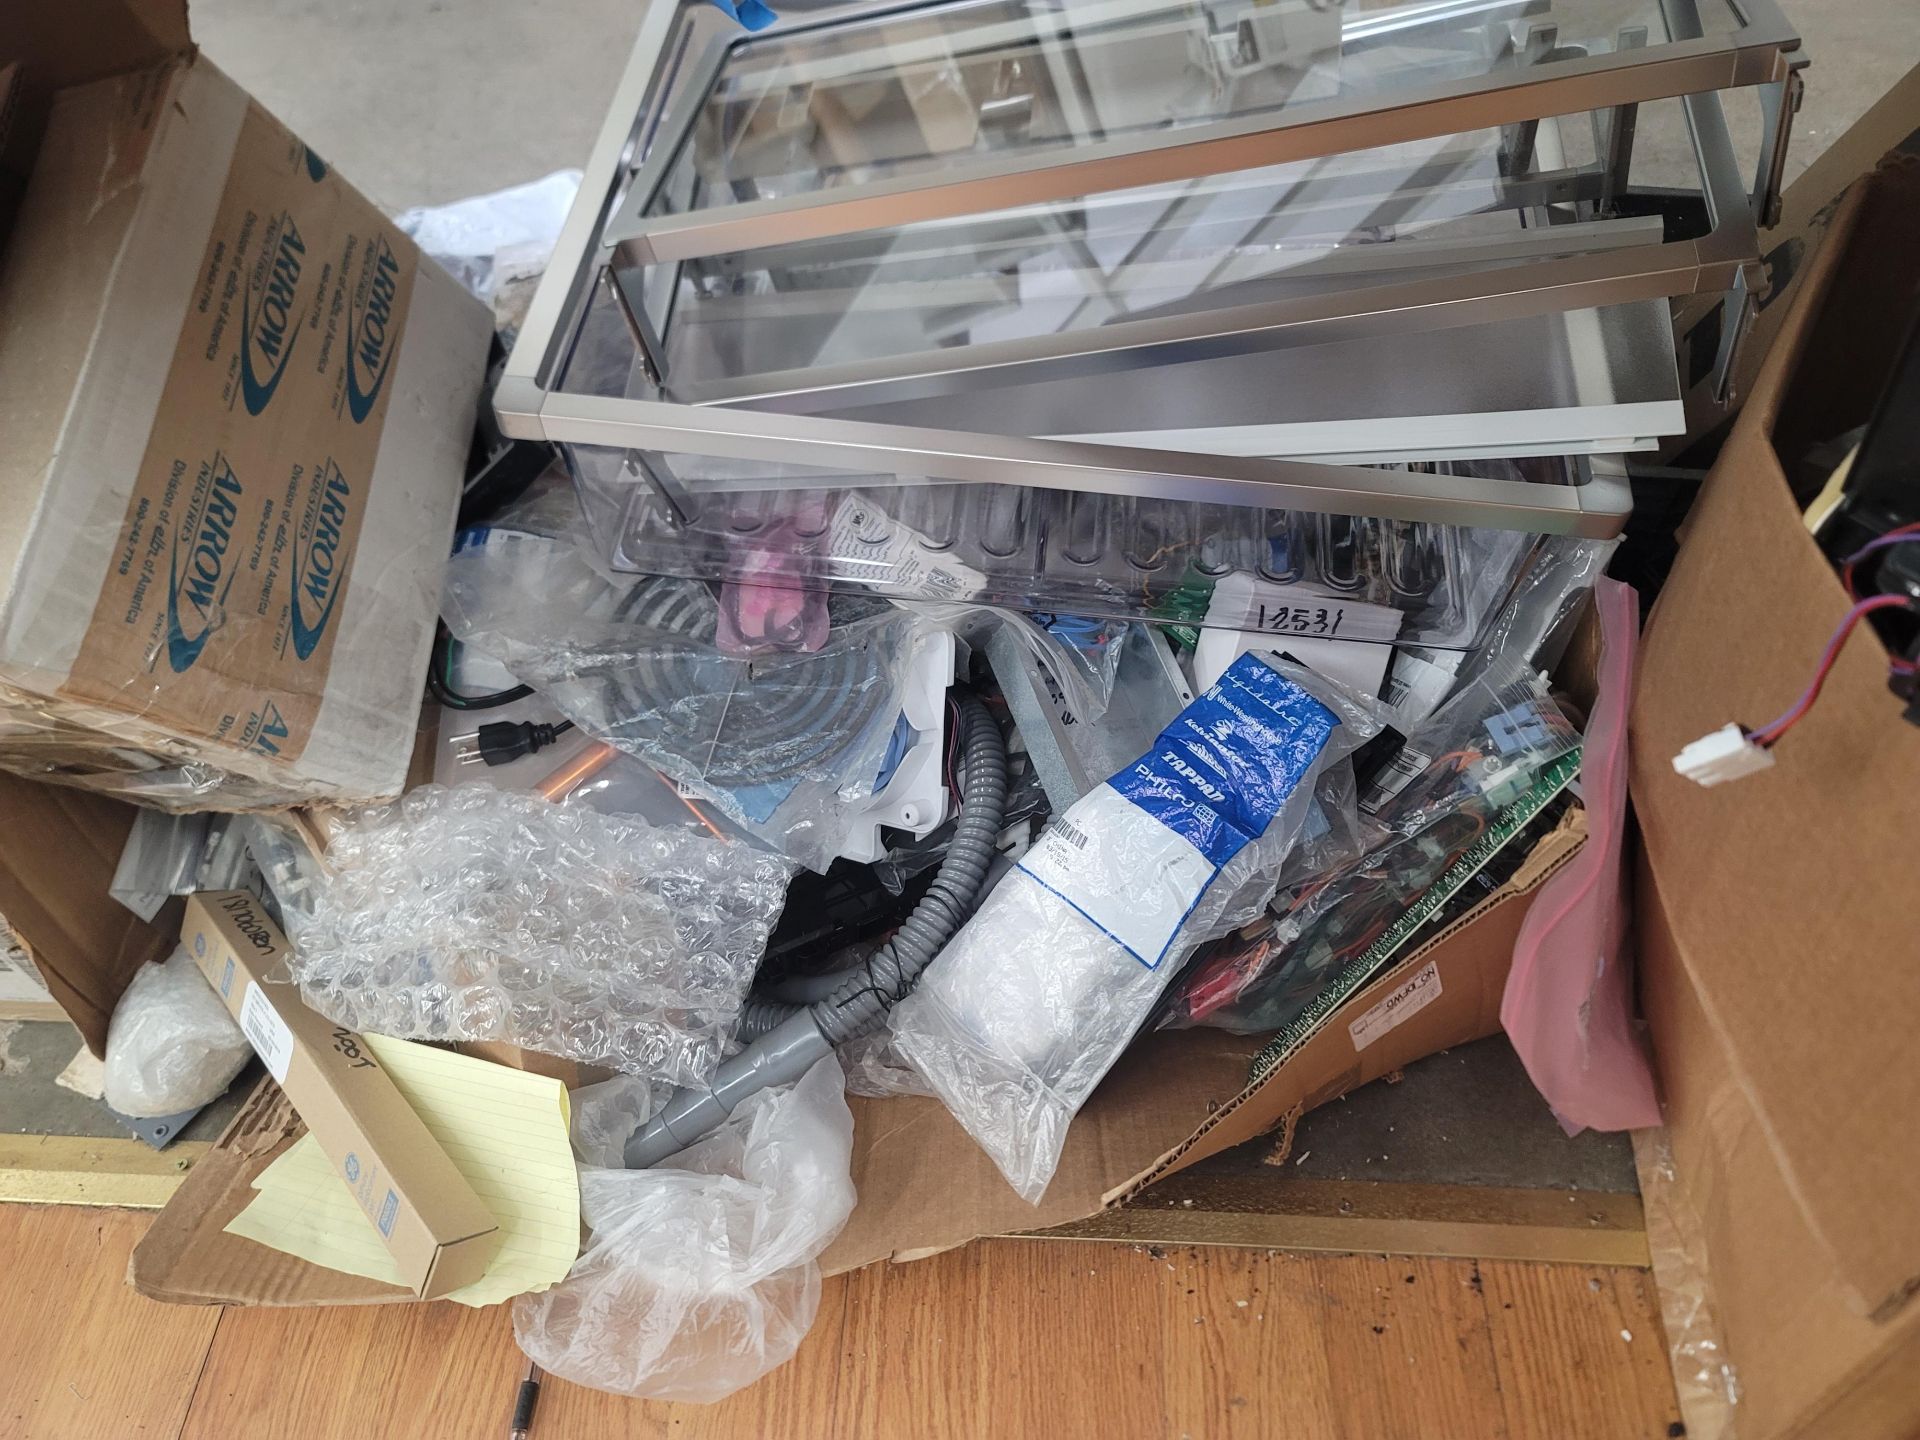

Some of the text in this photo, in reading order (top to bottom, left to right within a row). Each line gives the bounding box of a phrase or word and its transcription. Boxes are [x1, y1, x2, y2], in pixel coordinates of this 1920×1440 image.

[238, 210, 258, 255] Division
[256, 215, 306, 369] ARROW
[359, 238, 399, 380] ARROW
[207, 314, 228, 361] America
[164, 459, 187, 508] Division
[181, 460, 211, 544] INDUSTRIES
[286, 464, 304, 510] Division
[299, 464, 325, 541] INDUSTRIES
[183, 456, 243, 621] ARROW
[303, 459, 350, 614] ARROW
[125, 572, 154, 624] America
[257, 569, 281, 616] America
[1225, 670, 1301, 727] rigidaire
[1135, 763, 1195, 808] PHILCO
[1161, 751, 1226, 802] TAPPAN
